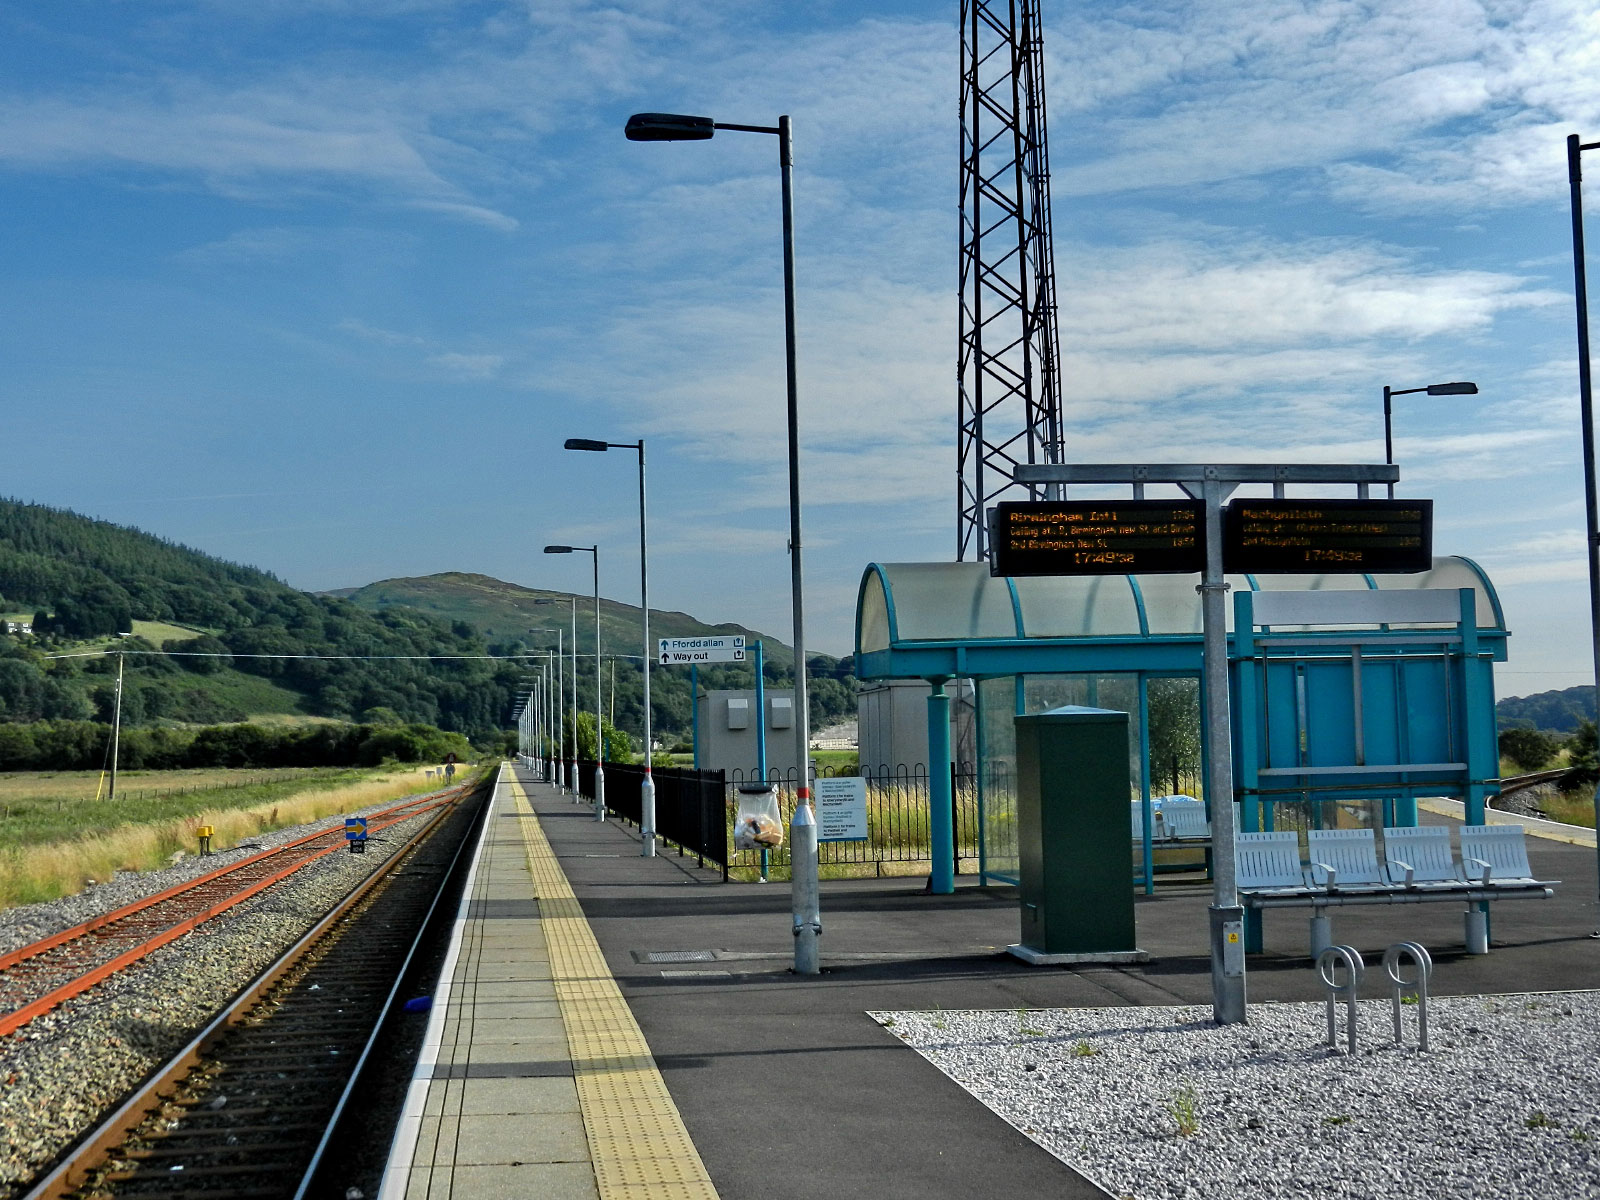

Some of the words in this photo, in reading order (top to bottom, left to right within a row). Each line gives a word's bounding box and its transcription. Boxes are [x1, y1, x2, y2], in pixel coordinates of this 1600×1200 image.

[1010, 512, 1083, 523] Birmingham
[672, 640, 702, 648] Ffordd
[702, 639, 723, 647] allan
[673, 653, 691, 661] Way
